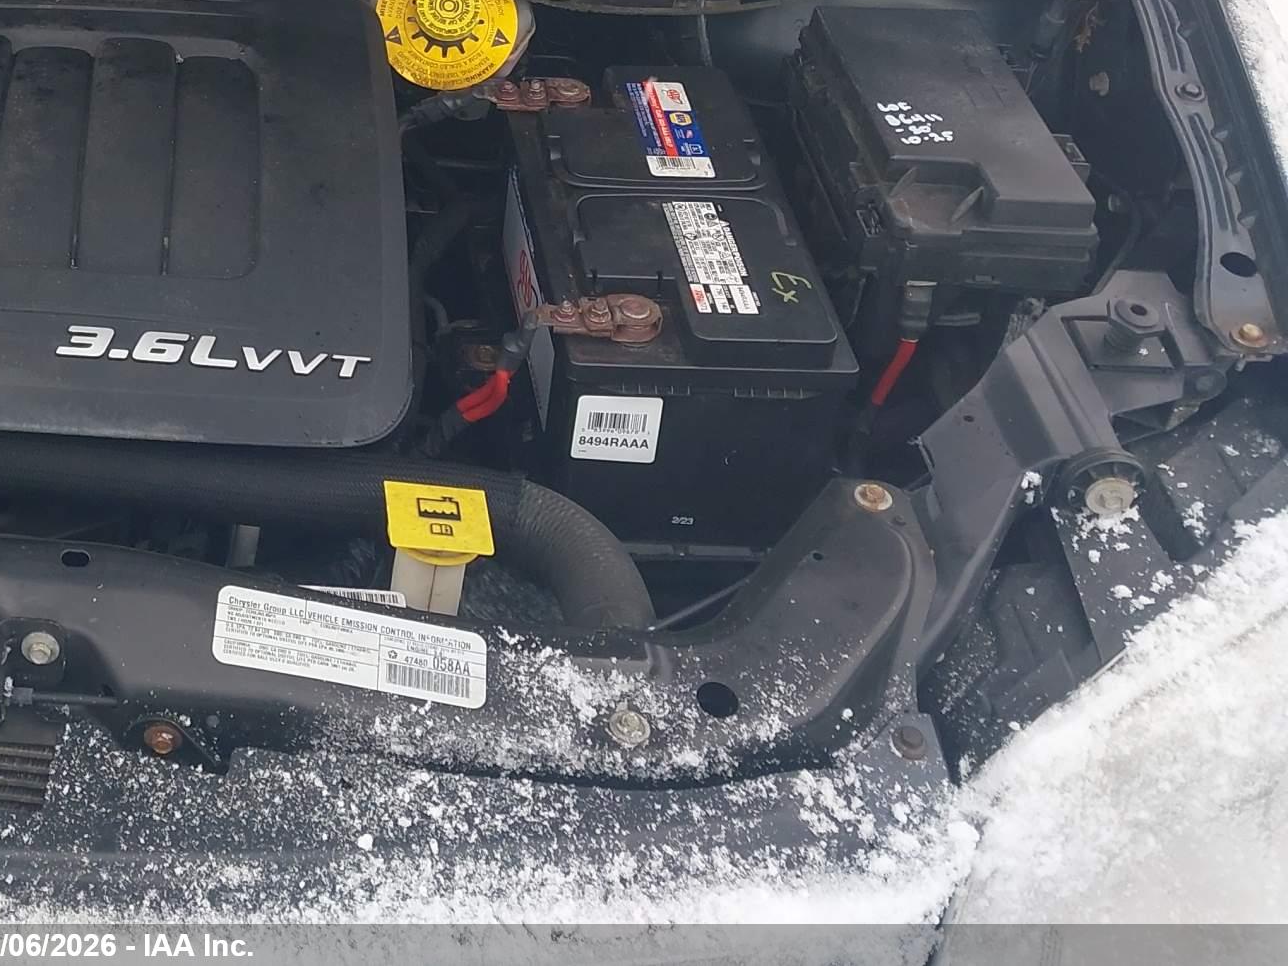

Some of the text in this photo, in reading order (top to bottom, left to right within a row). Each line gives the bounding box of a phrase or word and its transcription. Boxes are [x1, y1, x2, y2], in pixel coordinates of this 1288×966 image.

[578, 435, 649, 450] 8494RAAA
[672, 516, 694, 525] 2/23
[228, 596, 306, 618] Chrysler Group LLC
[308, 612, 338, 624] VEHICLE
[341, 617, 378, 632] EMISSION
[380, 626, 415, 640] CONTROL
